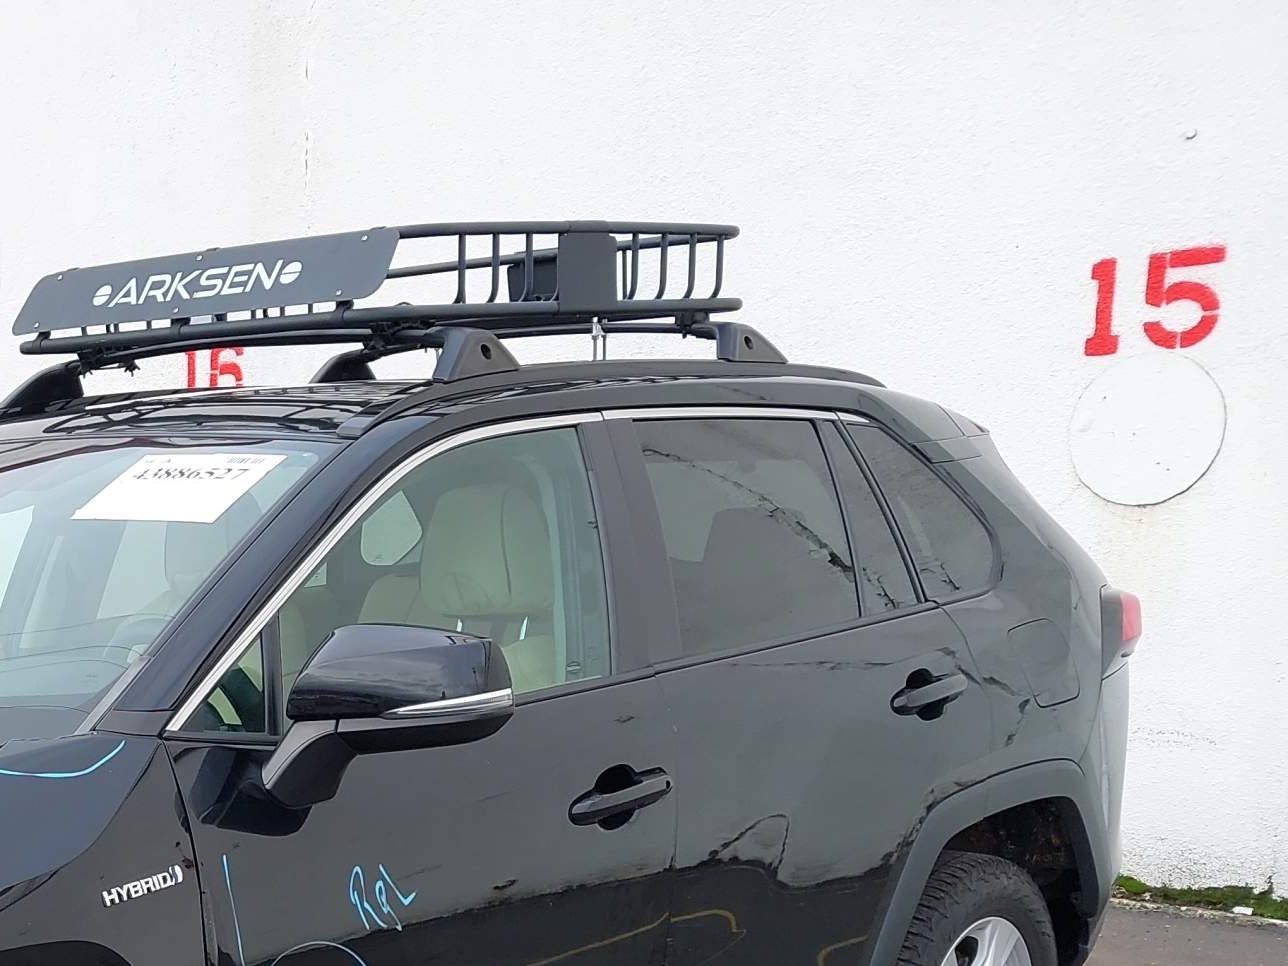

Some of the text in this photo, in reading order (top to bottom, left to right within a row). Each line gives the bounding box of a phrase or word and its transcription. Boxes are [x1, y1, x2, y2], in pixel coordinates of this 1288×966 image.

[107, 259, 284, 308] ARKSEN
[1083, 245, 1227, 357] 15
[184, 346, 245, 391] 16
[101, 871, 176, 907] HYBRID
